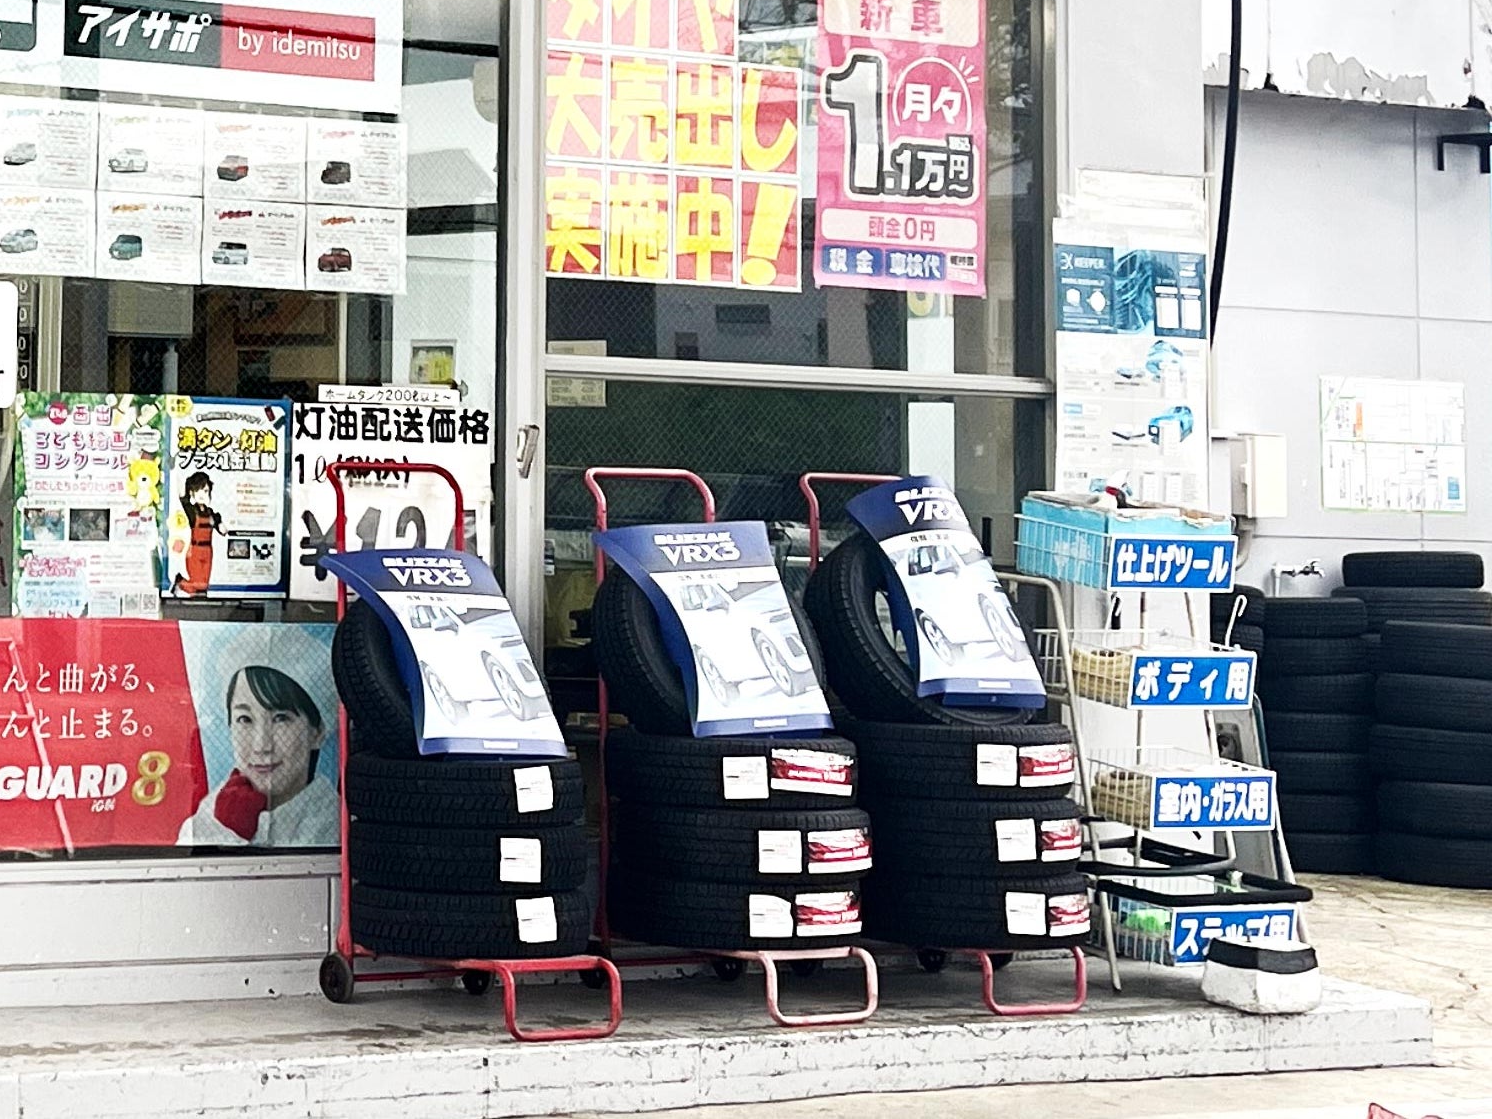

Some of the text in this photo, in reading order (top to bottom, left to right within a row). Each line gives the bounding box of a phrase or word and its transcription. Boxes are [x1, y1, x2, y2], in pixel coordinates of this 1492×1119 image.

[75, 3, 213, 54] アイサポ
[237, 30, 362, 61] by idemitsu
[545, 52, 798, 173] 大売出し
[902, 82, 962, 125] 月々
[868, 216, 936, 242] 頭金0円
[294, 403, 490, 445] 灯油配送価格
[658, 543, 741, 568] VRX3
[1116, 542, 1231, 584] 仕上げツール
[387, 566, 472, 588] VRX3
[1134, 659, 1251, 700] ボディ用
[131, 750, 171, 806] 8
[1157, 781, 1271, 823] 室内・ガラス用
